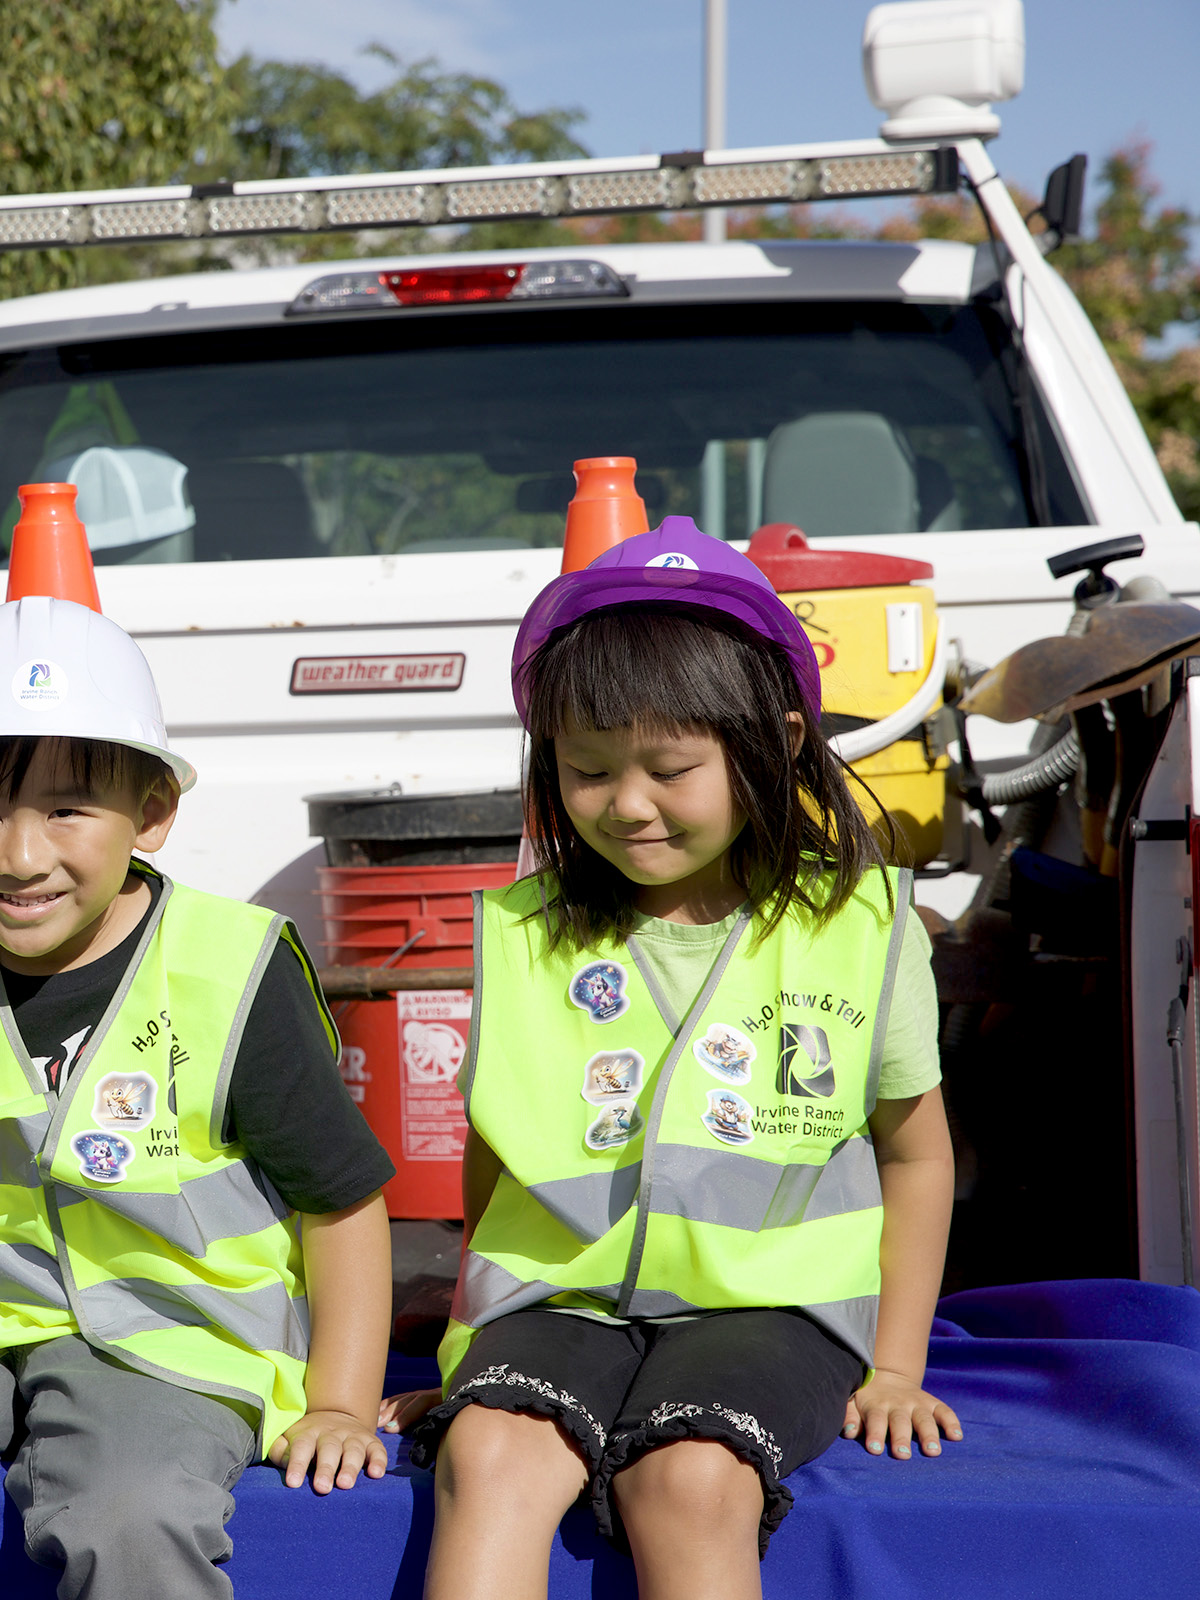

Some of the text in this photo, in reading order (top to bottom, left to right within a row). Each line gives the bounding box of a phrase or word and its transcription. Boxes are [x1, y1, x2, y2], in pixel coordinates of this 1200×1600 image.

[302, 661, 454, 682] weather guard
[774, 990, 817, 1012] Show
[820, 994, 833, 1012] &
[836, 998, 866, 1029] Tell
[755, 1105, 845, 1122] Irvine Ranch
[150, 1126, 178, 1141] Irvi
[751, 1119, 844, 1139] Water District
[146, 1144, 180, 1158] Wat
